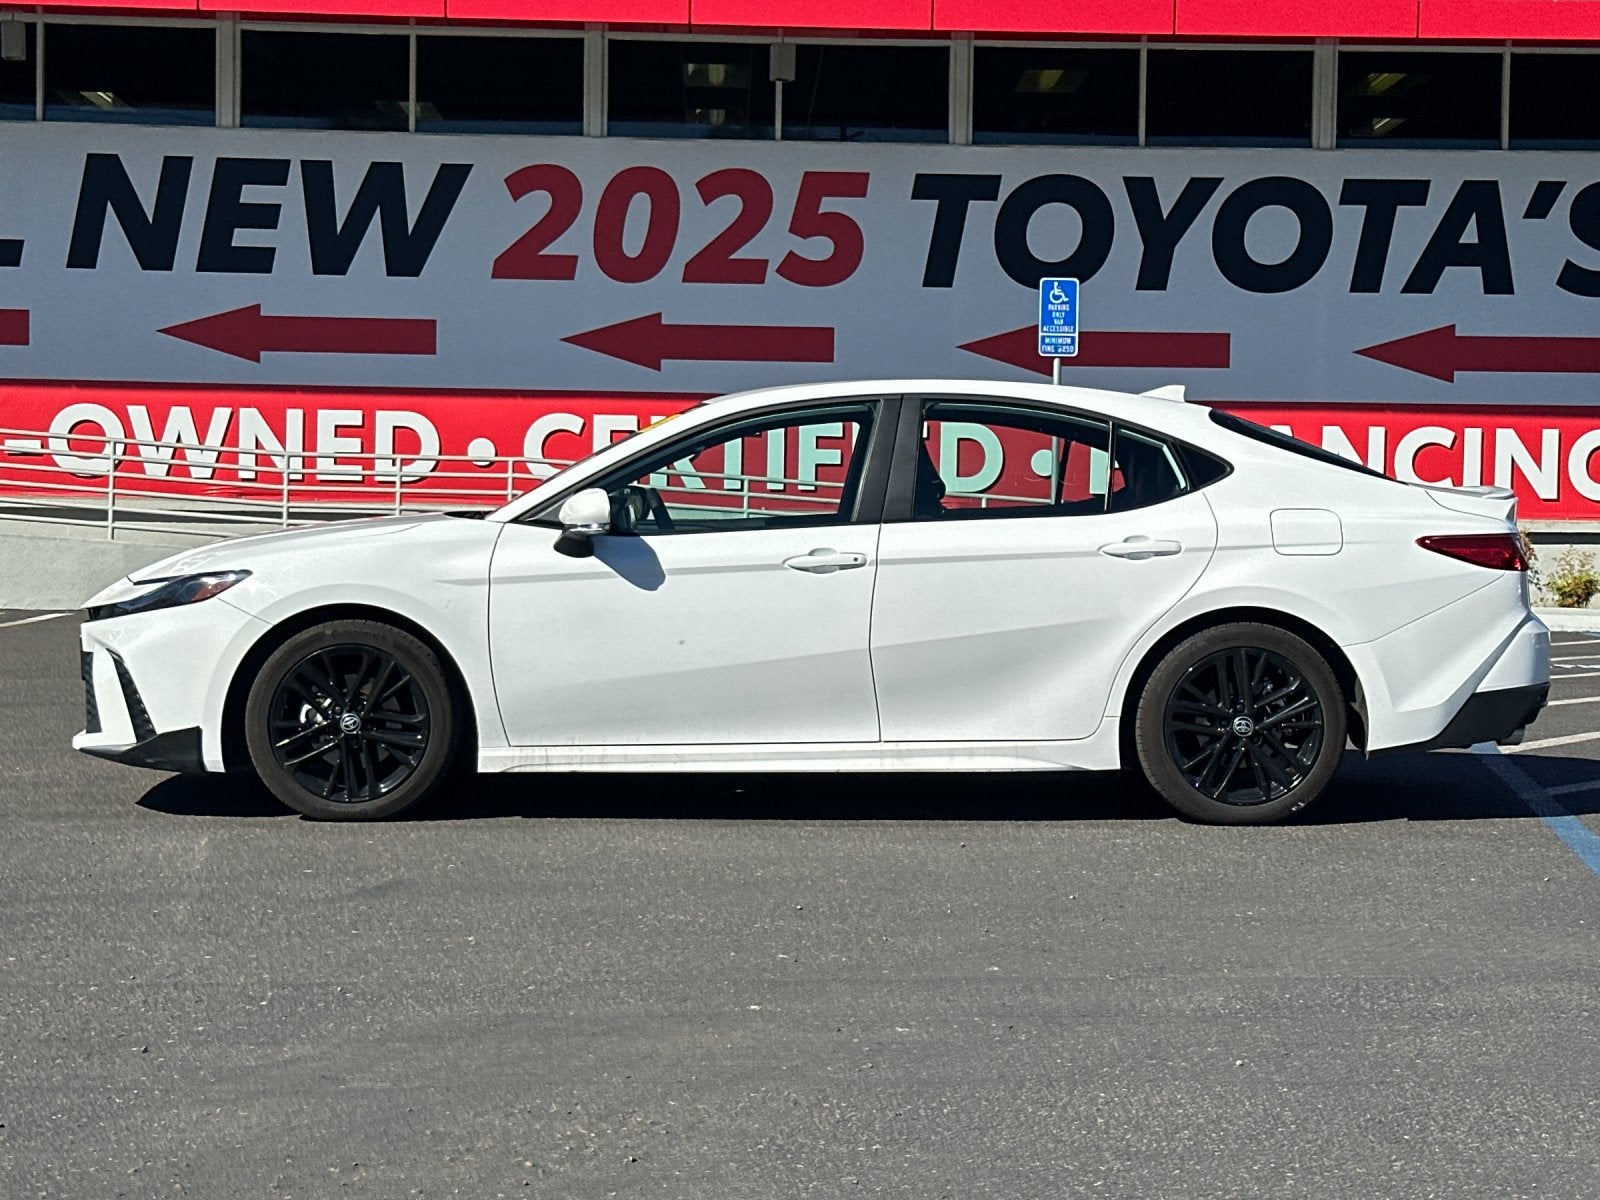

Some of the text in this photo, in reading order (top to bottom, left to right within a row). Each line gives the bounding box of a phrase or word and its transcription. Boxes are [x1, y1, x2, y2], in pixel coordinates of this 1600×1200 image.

[66, 152, 475, 278] NEW
[490, 163, 871, 288] 2025
[1052, 311, 1065, 319] ONLY
[1041, 345, 1055, 353] FINE
